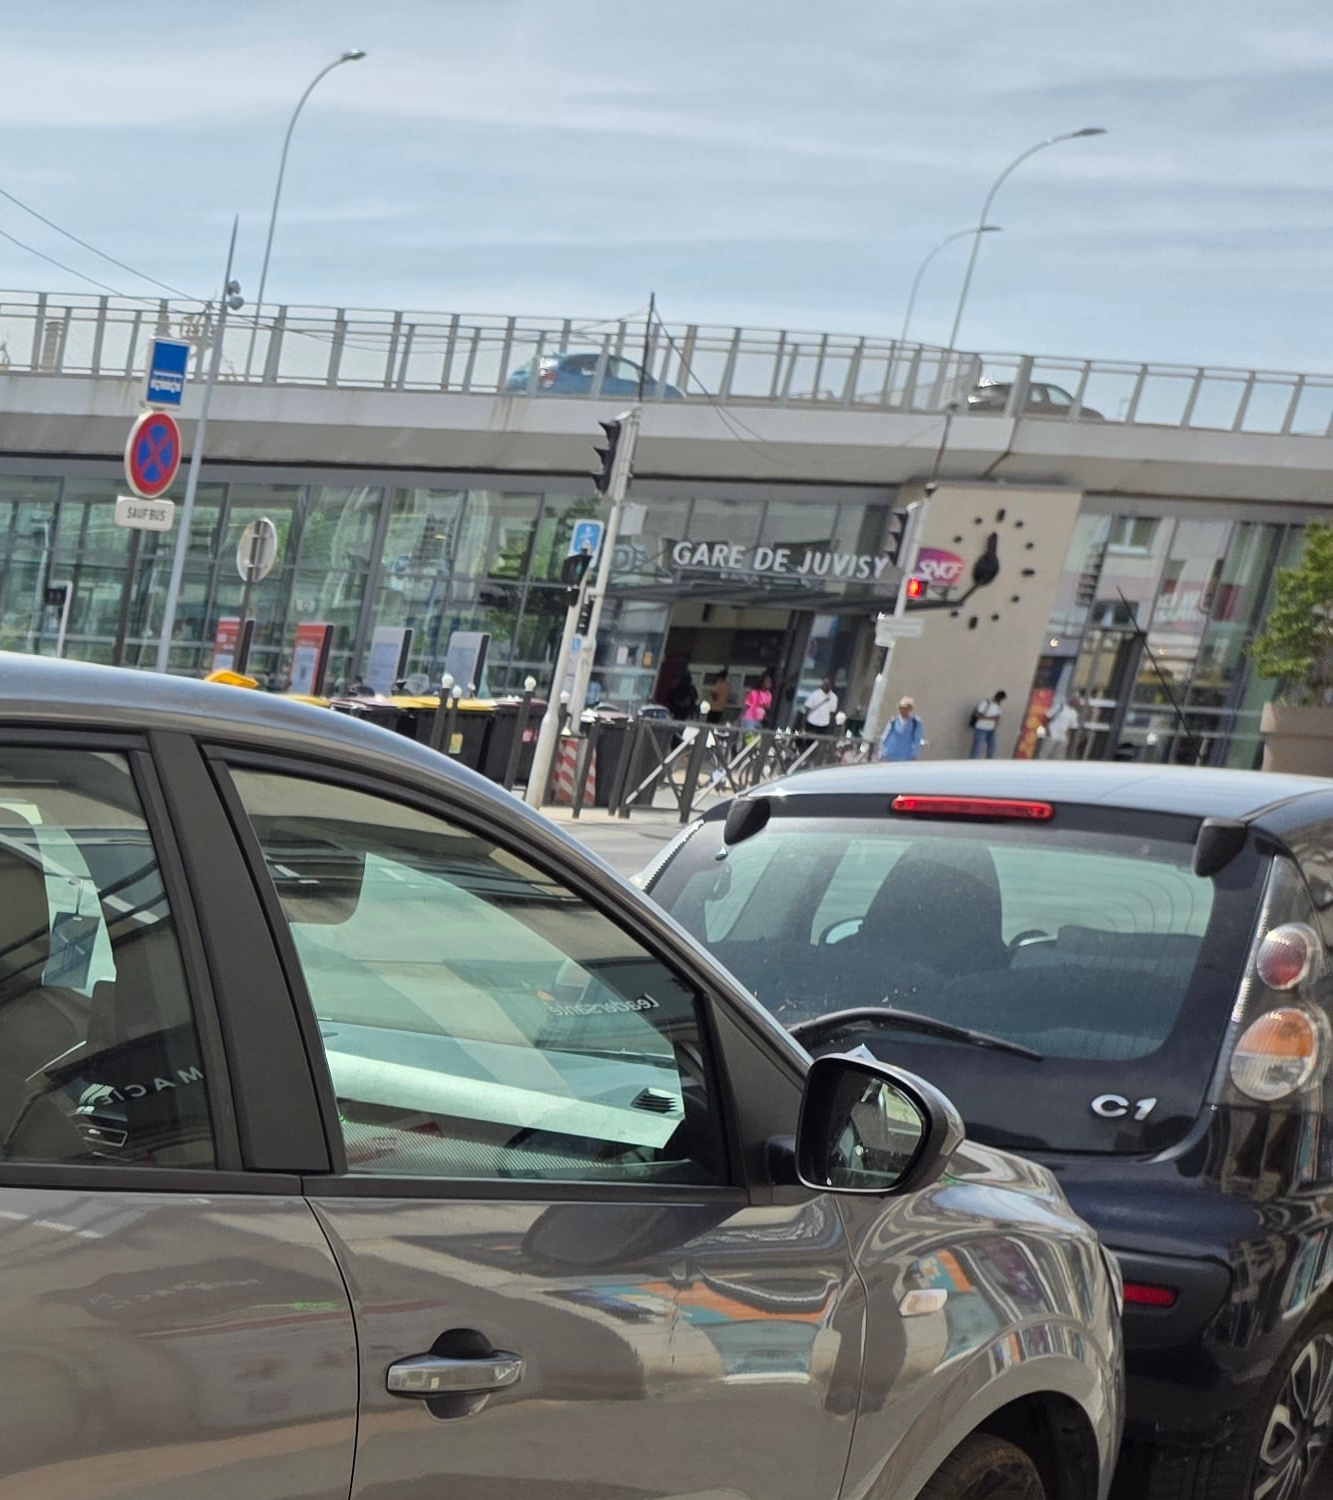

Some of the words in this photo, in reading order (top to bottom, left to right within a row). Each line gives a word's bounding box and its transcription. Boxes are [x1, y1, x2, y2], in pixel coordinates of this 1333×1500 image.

[126, 506, 148, 520] SAUF
[149, 509, 166, 522] BUS
[673, 541, 746, 569] GARE
[753, 546, 791, 572] DE
[797, 550, 890, 579] JUVISY
[1091, 1094, 1157, 1120] C1
